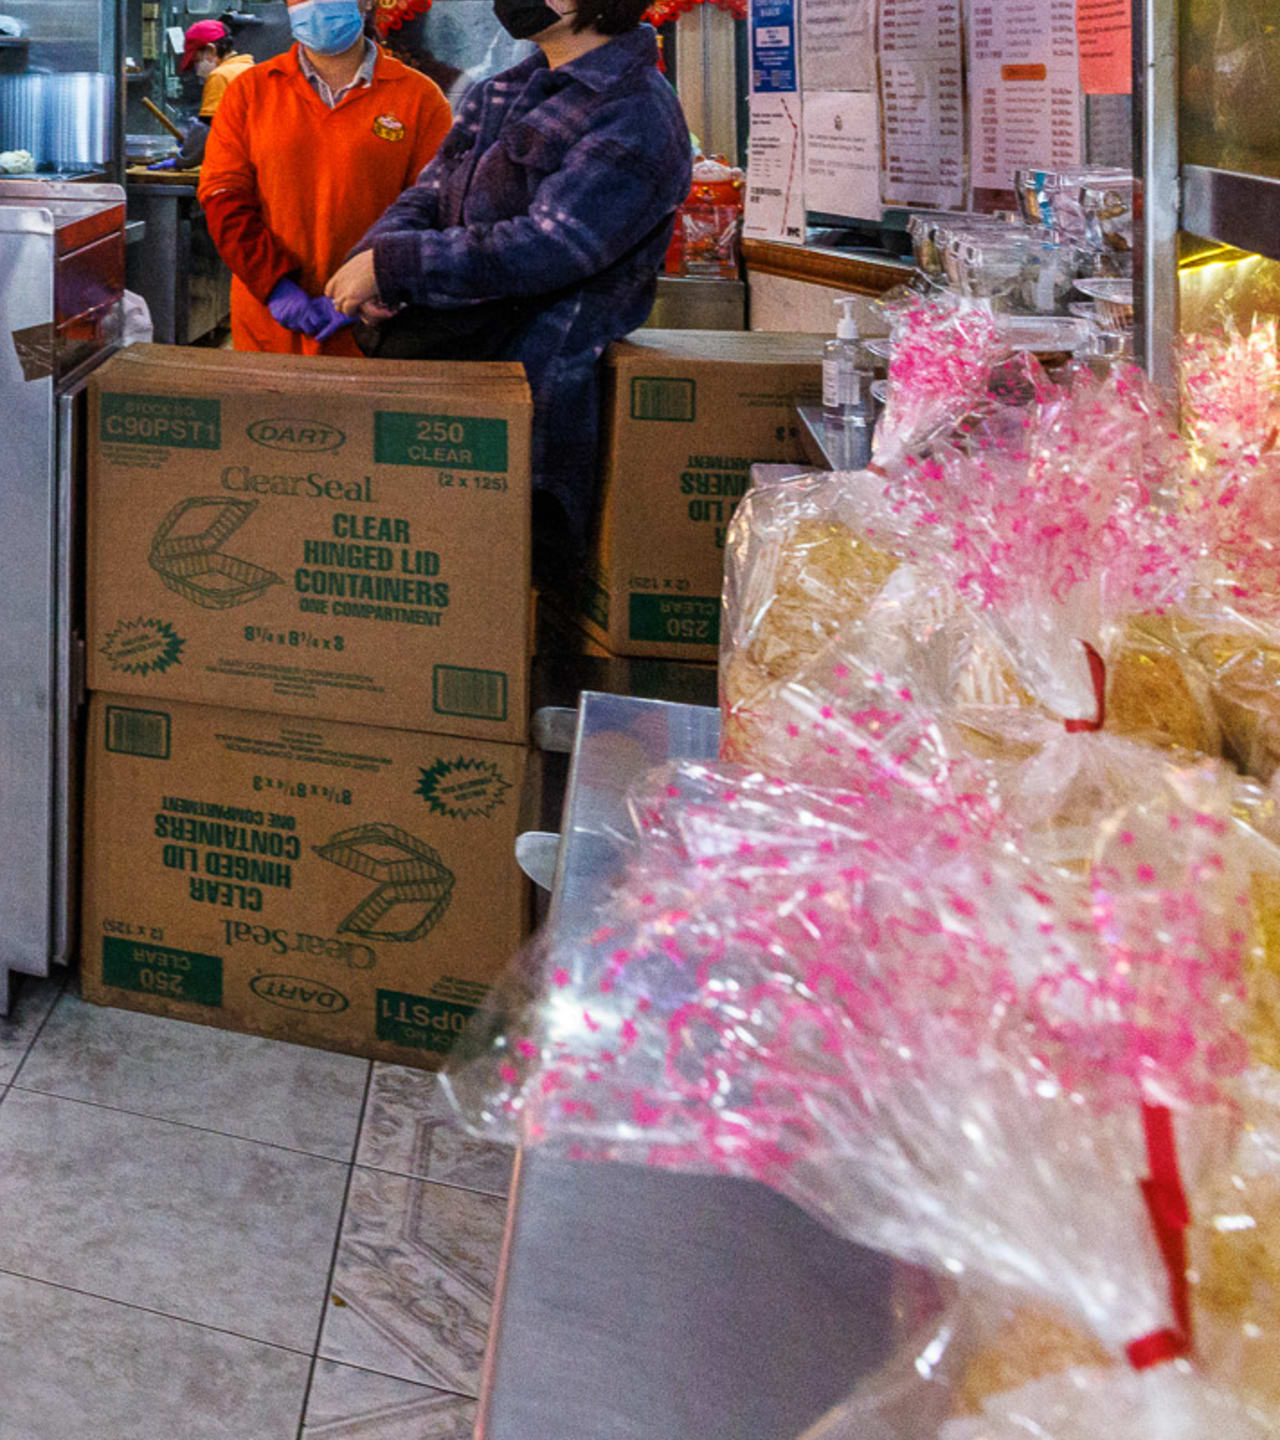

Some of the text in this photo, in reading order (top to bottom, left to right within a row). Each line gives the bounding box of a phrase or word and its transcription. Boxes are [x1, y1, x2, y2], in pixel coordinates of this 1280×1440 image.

[105, 415, 217, 442] C90PST1
[258, 425, 335, 445] DART
[416, 420, 464, 443] 250
[407, 446, 473, 464] CLEAR
[220, 465, 377, 503] ClearSeal
[688, 499, 723, 523] LID
[332, 513, 410, 544] CLEAR
[303, 539, 441, 578] HINGED LID
[295, 568, 450, 609] CONTAINERS
[299, 597, 444, 628] ONE COMPARTMENT
[659, 601, 716, 617] CLEAR
[666, 618, 711, 638] 250
[161, 795, 296, 829] ONE COMPARTMENT
[154, 813, 300, 860] CONTAINERS
[162, 844, 292, 889] HINGED LID
[190, 876, 263, 912] CLEAR
[220, 918, 376, 969] ClearSeal
[132, 948, 192, 973] CLEAR
[140, 967, 184, 994] 250
[259, 978, 340, 1009] DART
